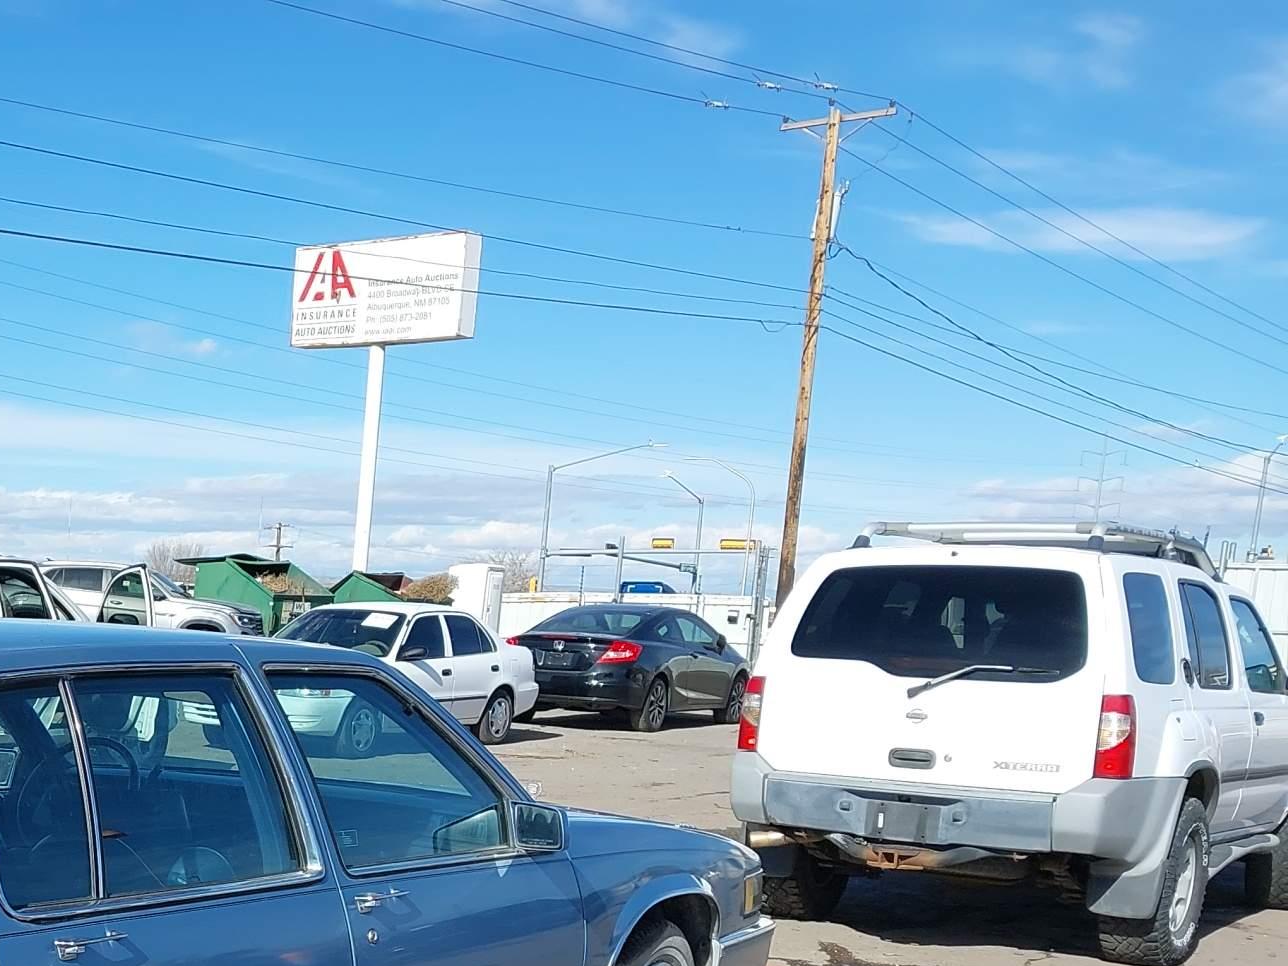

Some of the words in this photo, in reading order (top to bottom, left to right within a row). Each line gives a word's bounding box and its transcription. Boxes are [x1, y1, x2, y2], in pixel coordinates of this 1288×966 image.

[406, 275, 423, 284] Auto
[425, 272, 459, 282] Auctions
[368, 290, 385, 298] 4400
[386, 288, 420, 298] Broadway
[414, 299, 427, 307] NM
[428, 297, 450, 306] 87105
[296, 308, 357, 321] INSURANCE
[295, 327, 316, 336] AUTO
[317, 324, 355, 335] AUCTIONS
